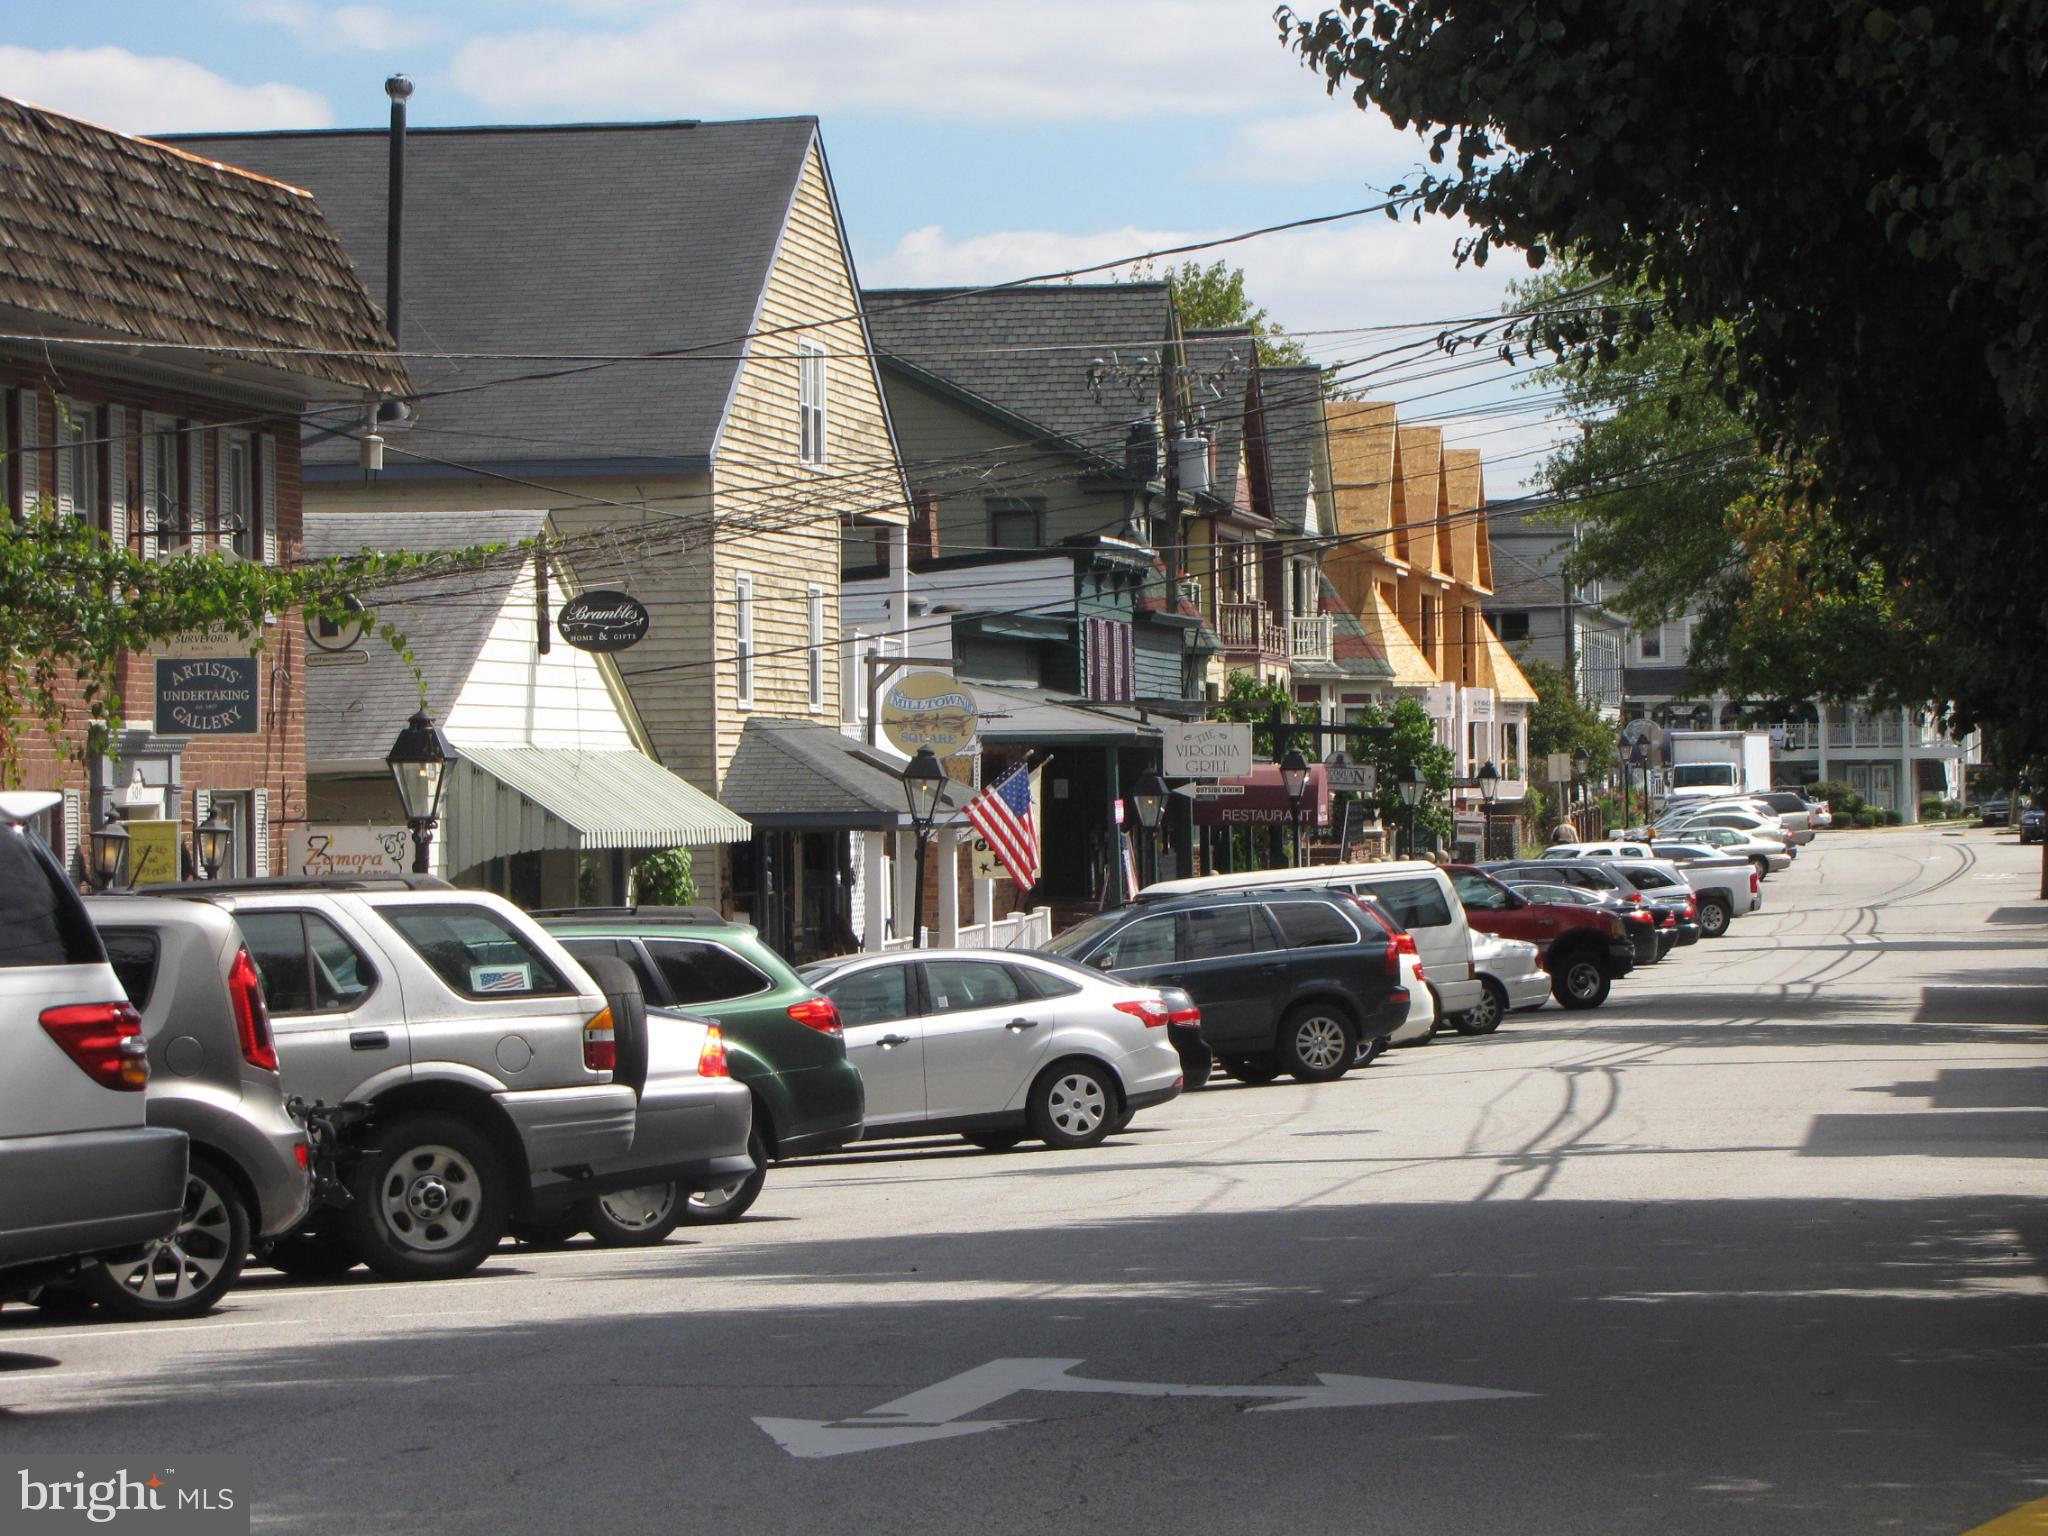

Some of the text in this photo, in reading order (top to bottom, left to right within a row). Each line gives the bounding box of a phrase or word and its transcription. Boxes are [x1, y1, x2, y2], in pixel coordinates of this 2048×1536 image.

[566, 602, 638, 620] Brambles
[175, 634, 230, 644] SURVEYORS
[598, 632, 608, 640] &
[172, 662, 243, 686] ARTISTS'
[163, 690, 250, 701] UNDERTAKING
[172, 706, 243, 730] GALLERY
[901, 732, 957, 744] SQUARE
[1195, 728, 1216, 743] THE
[1176, 744, 1241, 757] VIRGINIA
[1185, 760, 1230, 774] GRILL
[1195, 785, 1244, 794] OUTSIDE DINING
[306, 847, 384, 866] Zamora
